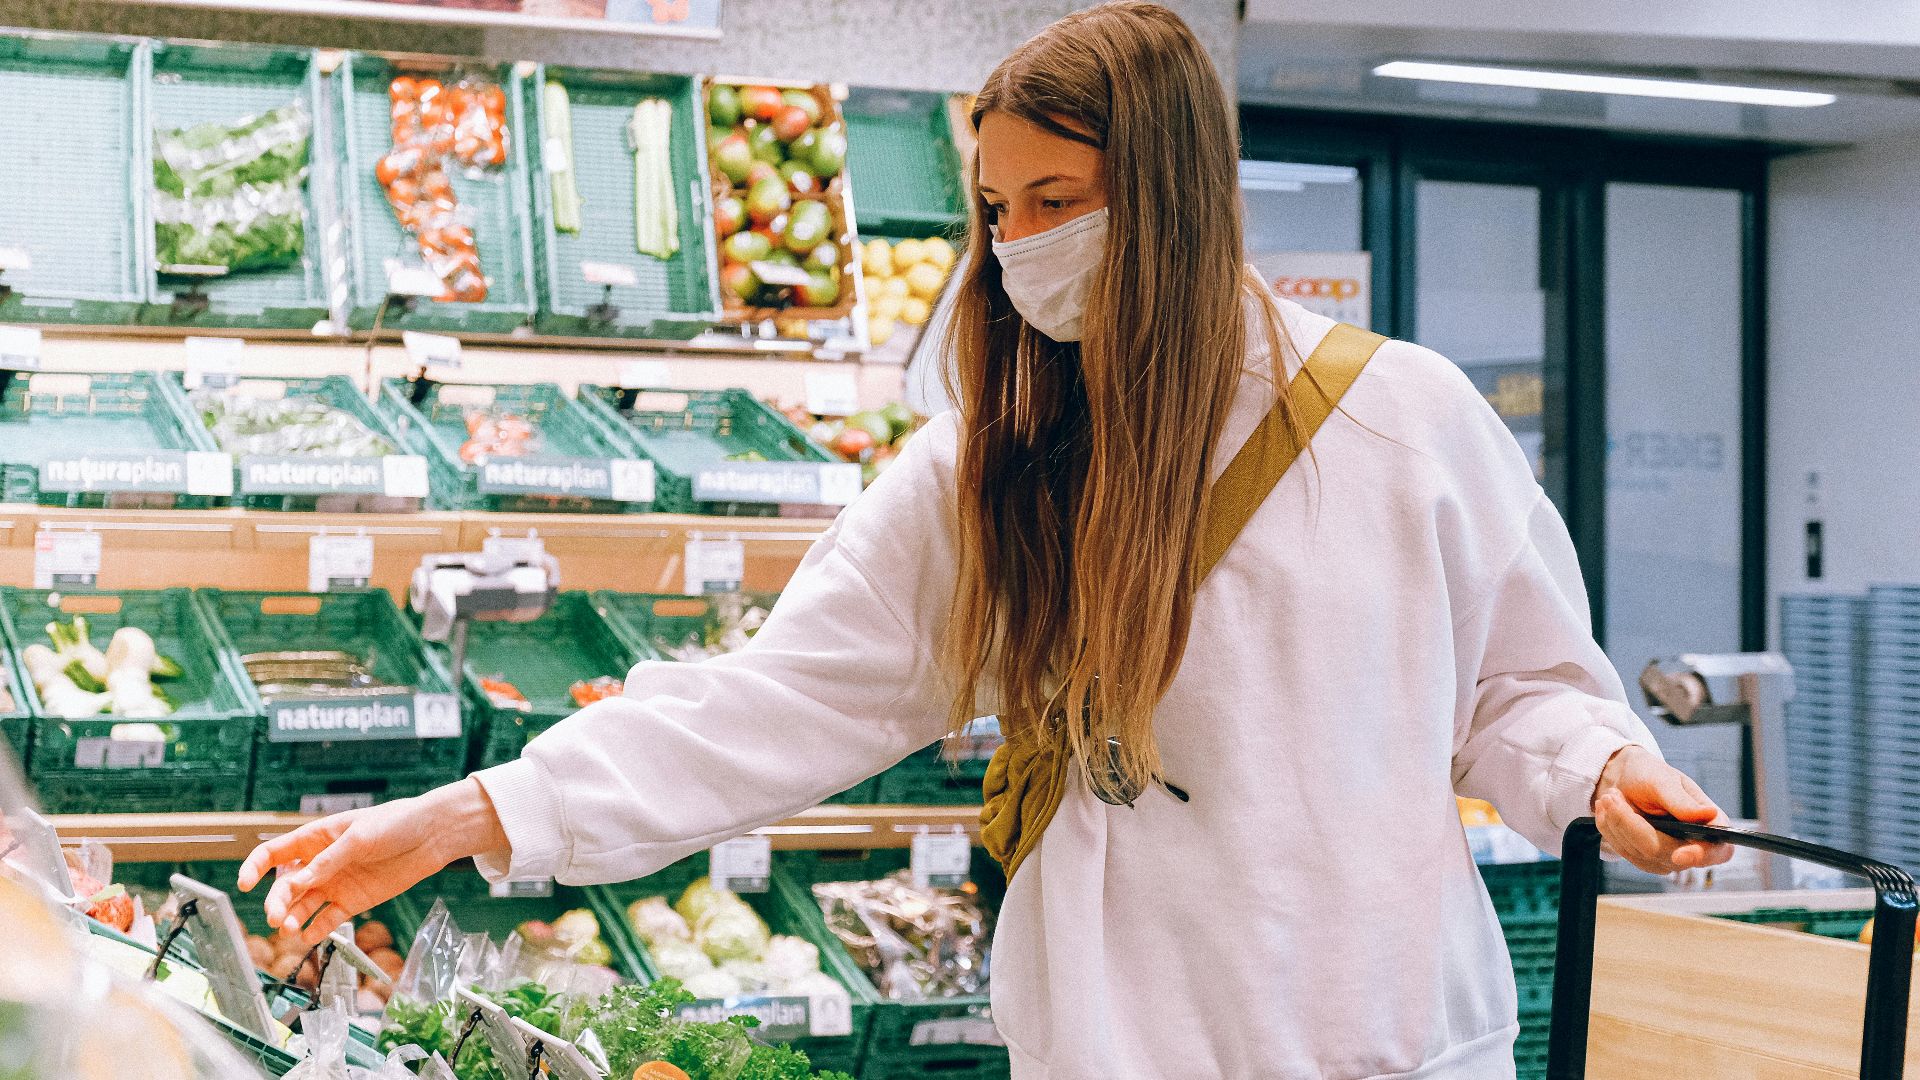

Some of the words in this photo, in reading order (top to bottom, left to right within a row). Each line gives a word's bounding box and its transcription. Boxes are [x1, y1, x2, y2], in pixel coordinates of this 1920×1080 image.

[1273, 277, 1360, 302] coop
[48, 456, 182, 487] naturaplan
[250, 461, 379, 489] naturaplan
[485, 461, 608, 492] naturaplan
[277, 702, 410, 733] naturaplan
